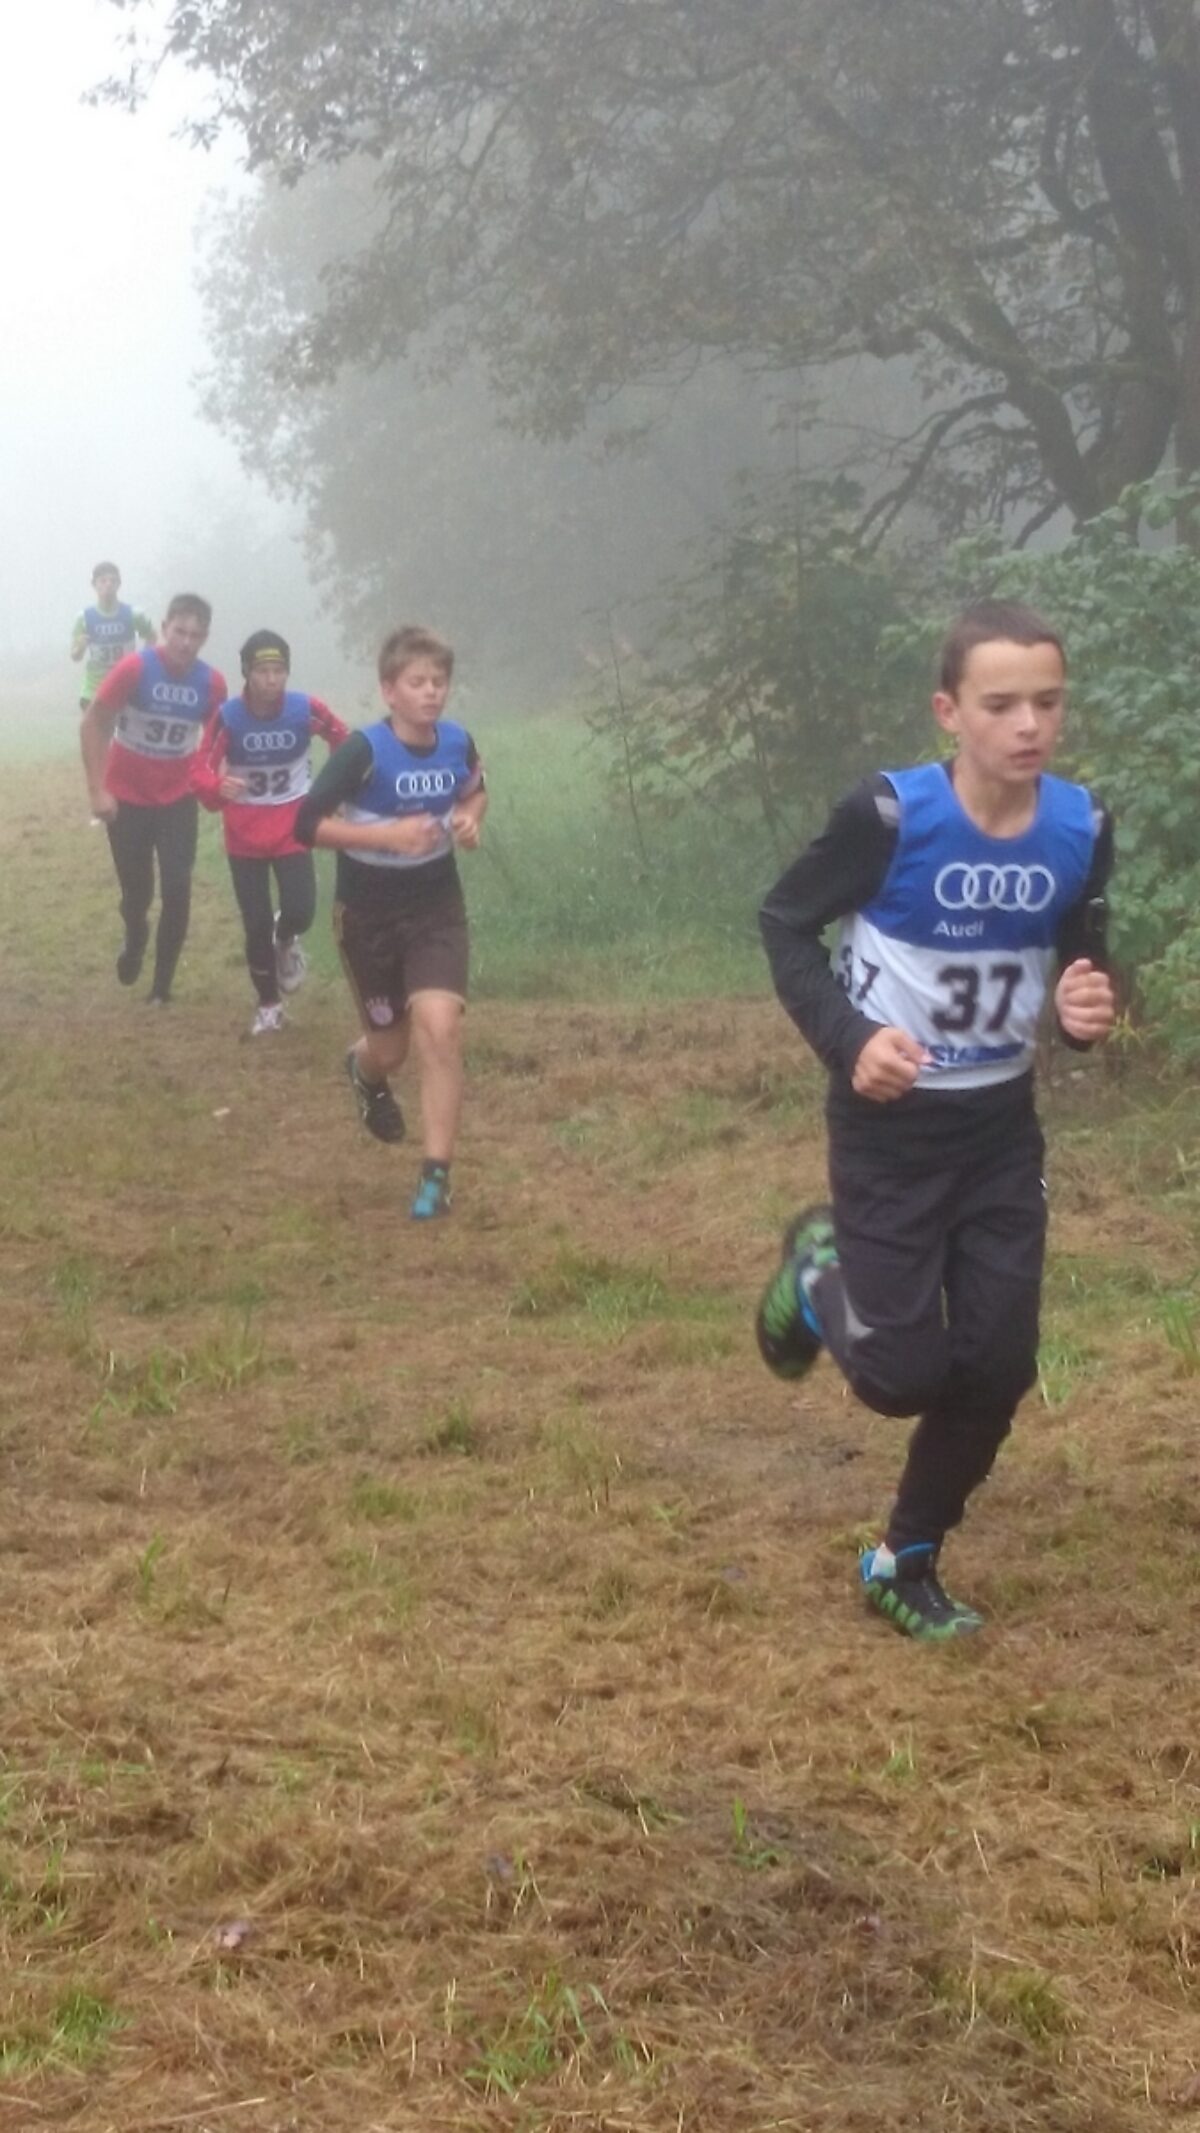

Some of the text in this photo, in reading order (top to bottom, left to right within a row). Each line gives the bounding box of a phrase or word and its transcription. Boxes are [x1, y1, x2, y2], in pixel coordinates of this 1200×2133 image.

[145, 719, 188, 746] 36
[248, 769, 290, 796] 32
[932, 920, 985, 938] Audi
[931, 963, 1024, 1032] 37
